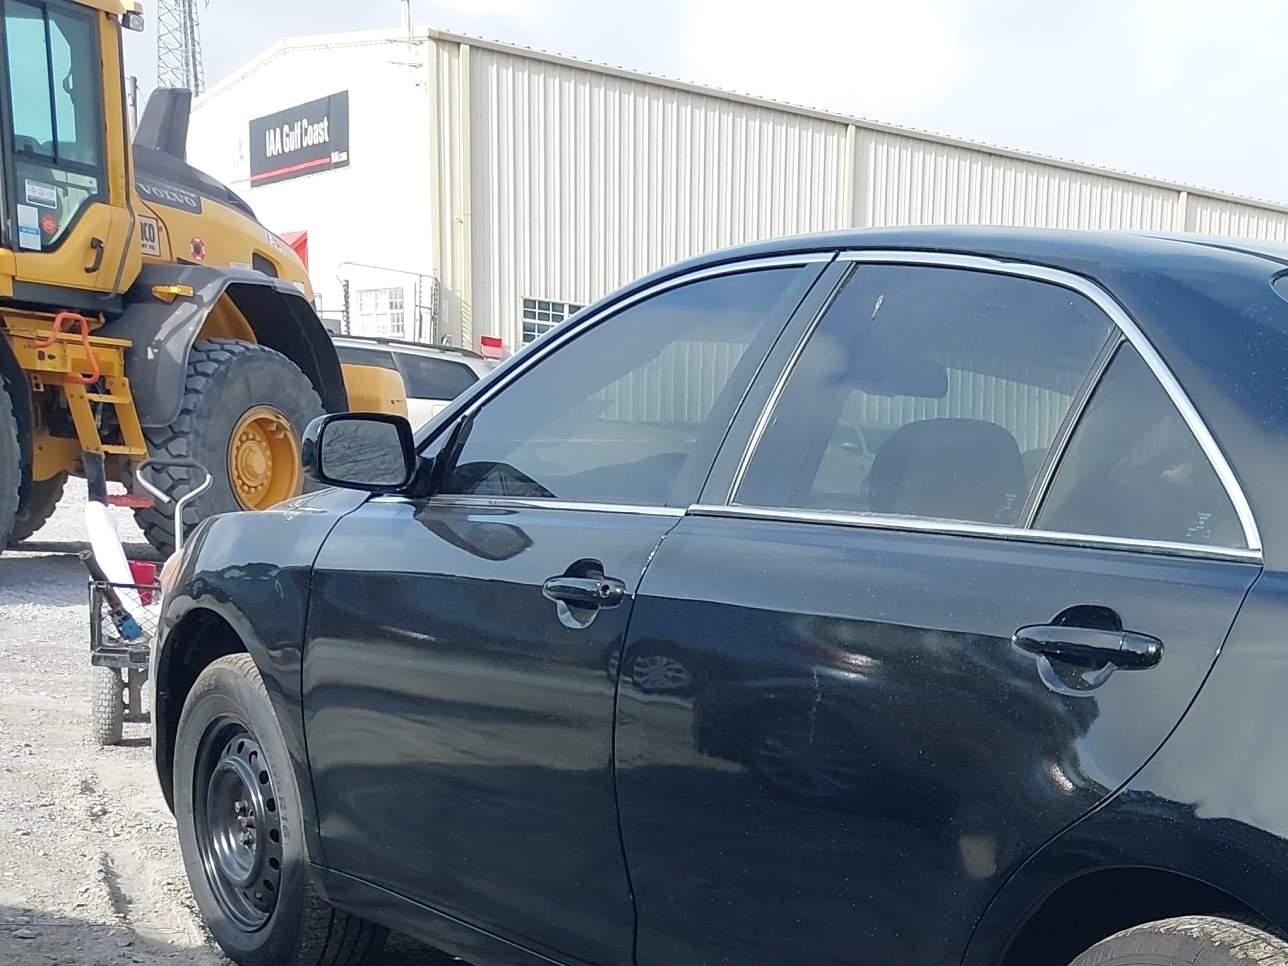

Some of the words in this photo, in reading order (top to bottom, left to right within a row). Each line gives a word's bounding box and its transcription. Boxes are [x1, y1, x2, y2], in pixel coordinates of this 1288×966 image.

[265, 127, 282, 158] IAA
[282, 120, 302, 153] Gulf
[302, 115, 329, 147] Coast
[138, 183, 197, 207] VOLVO
